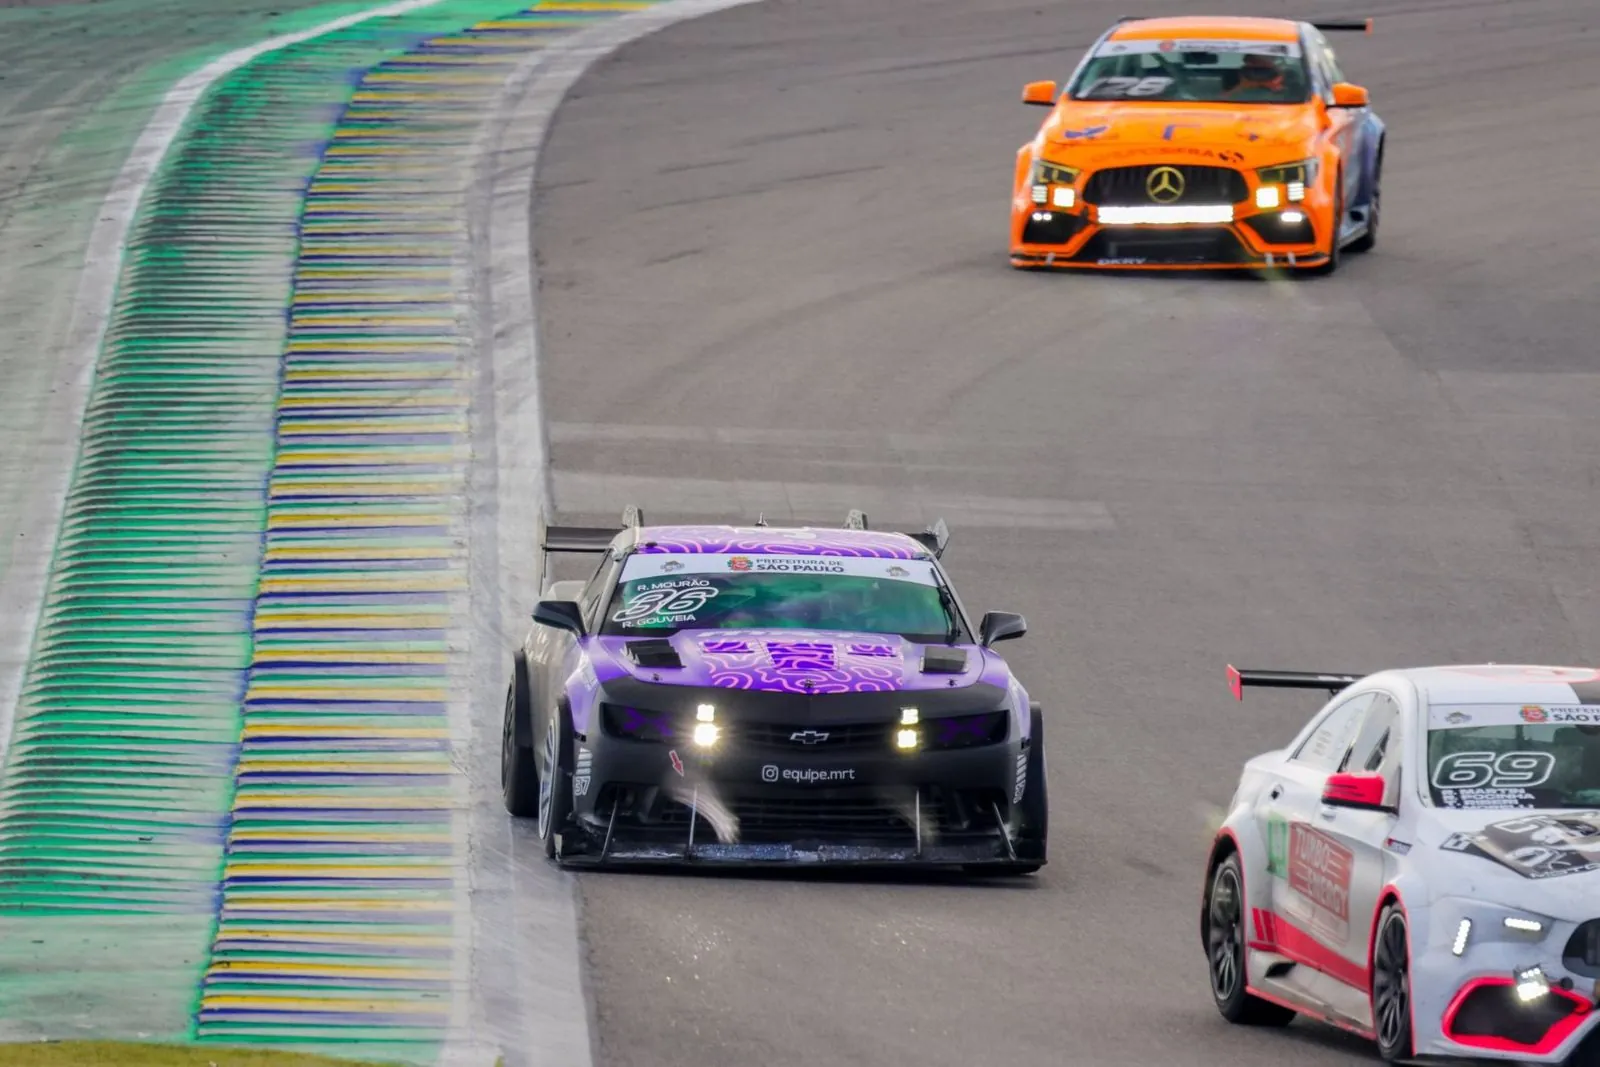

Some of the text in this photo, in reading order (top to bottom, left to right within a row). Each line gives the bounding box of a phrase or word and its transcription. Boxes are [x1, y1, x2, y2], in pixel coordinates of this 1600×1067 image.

[756, 558, 825, 566] PREFEITURA
[757, 563, 845, 573] SÃO PAULO
[637, 579, 710, 592] R. MOURÃO
[622, 613, 697, 629] R. GOUVEIA
[782, 768, 855, 784] equipe.mrt
[1431, 751, 1556, 789] 69
